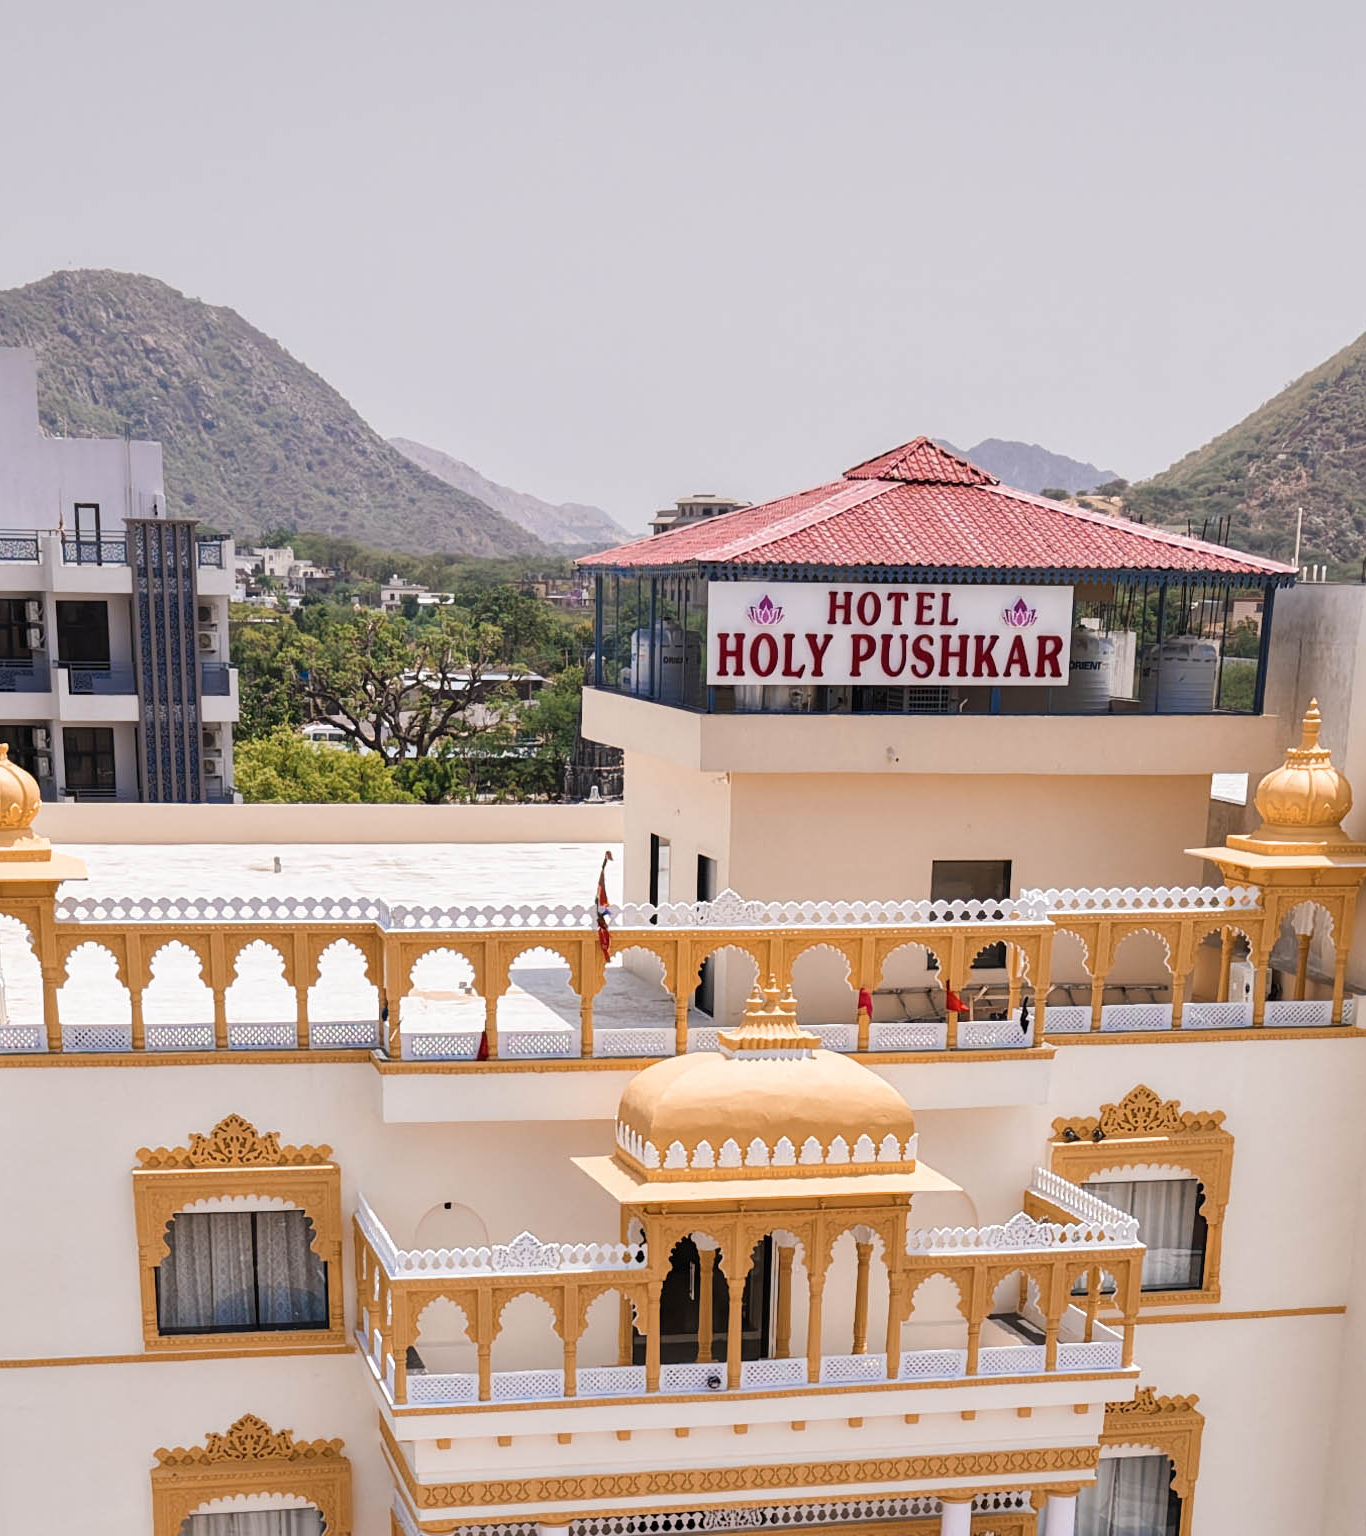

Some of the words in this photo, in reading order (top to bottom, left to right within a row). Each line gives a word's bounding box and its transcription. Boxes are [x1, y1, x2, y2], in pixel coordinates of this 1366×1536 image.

[827, 591, 959, 626] HOTEL
[717, 633, 834, 679] HOLY
[850, 634, 1064, 679] PUSHKAR
[1069, 661, 1102, 671] ORIENT
